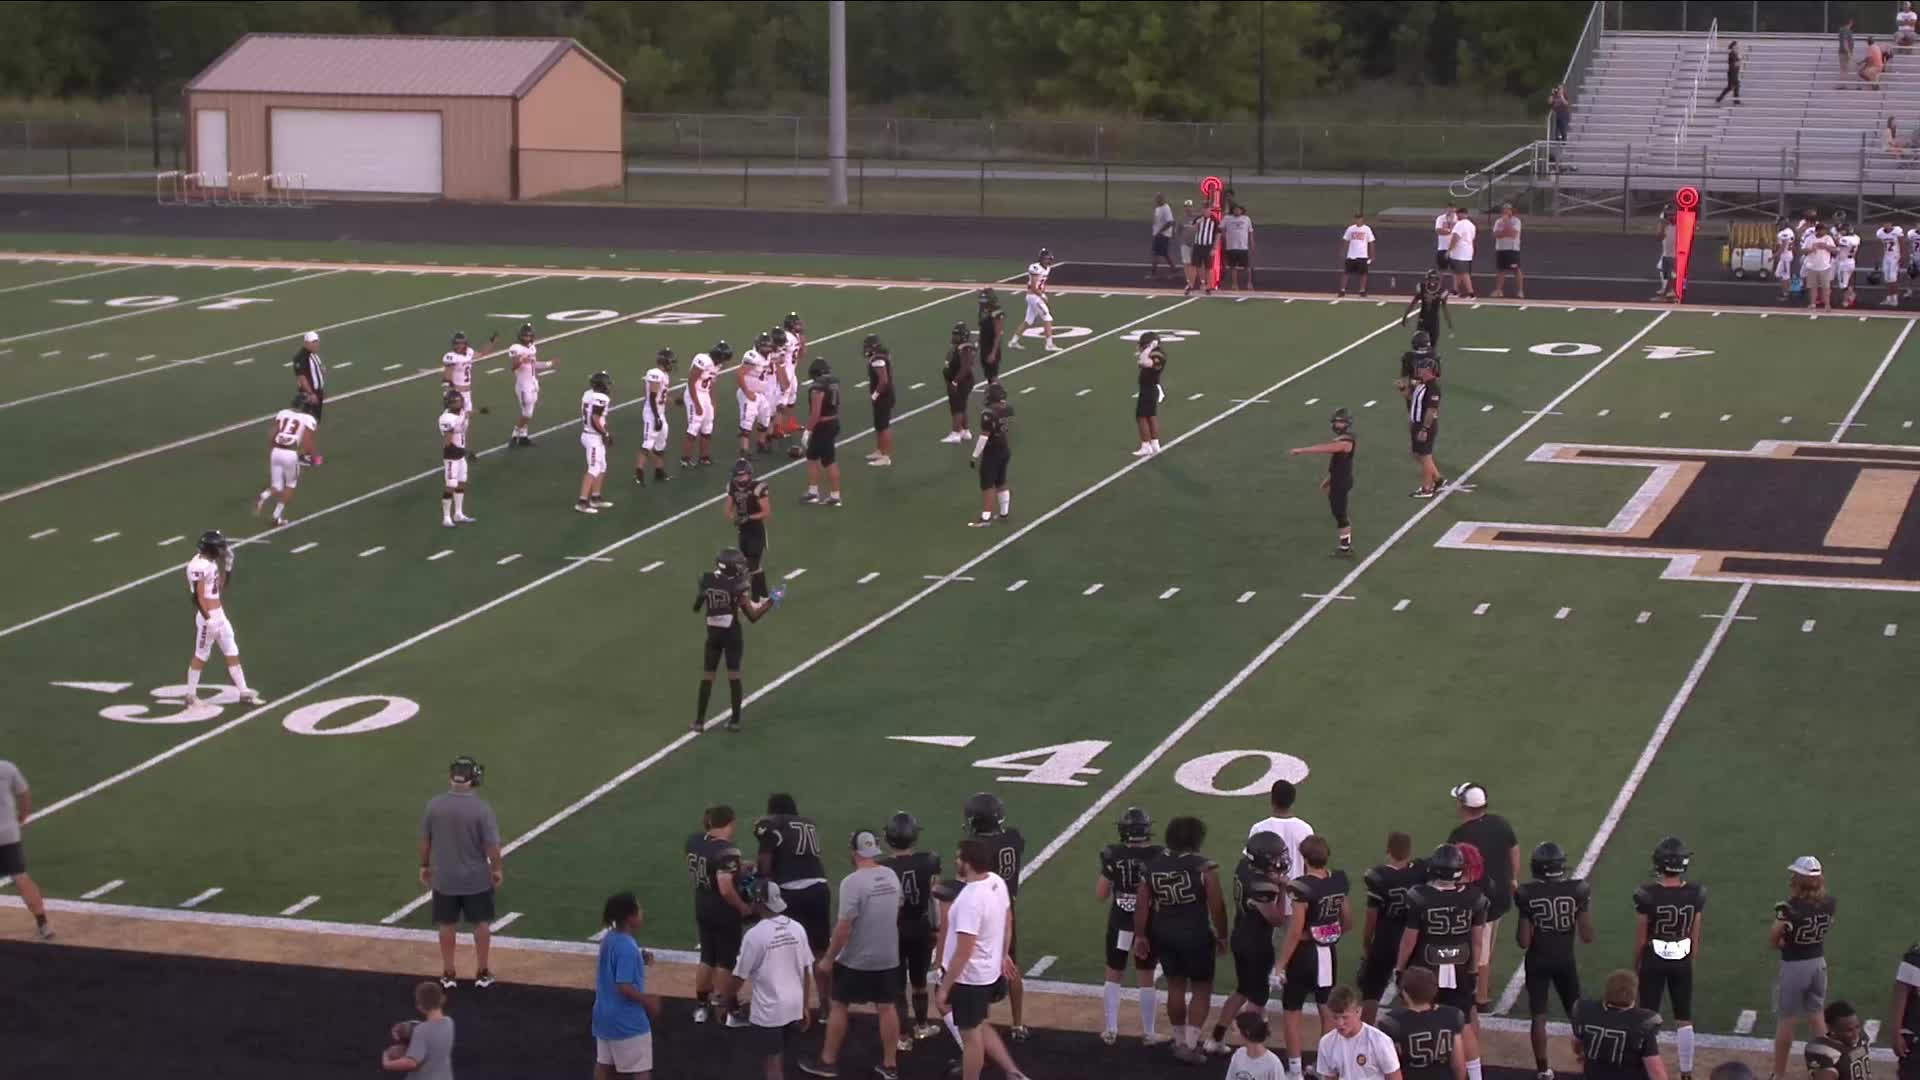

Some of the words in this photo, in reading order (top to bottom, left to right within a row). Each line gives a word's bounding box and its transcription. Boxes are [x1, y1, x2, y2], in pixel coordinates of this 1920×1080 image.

[1151, 870, 1196, 905] 52
[1427, 906, 1472, 935] 53
[1529, 896, 1577, 932] 28
[1656, 905, 1695, 938] 21
[1795, 914, 1834, 945] 22
[1408, 1029, 1453, 1068] 54
[1584, 1024, 1626, 1066] 77
